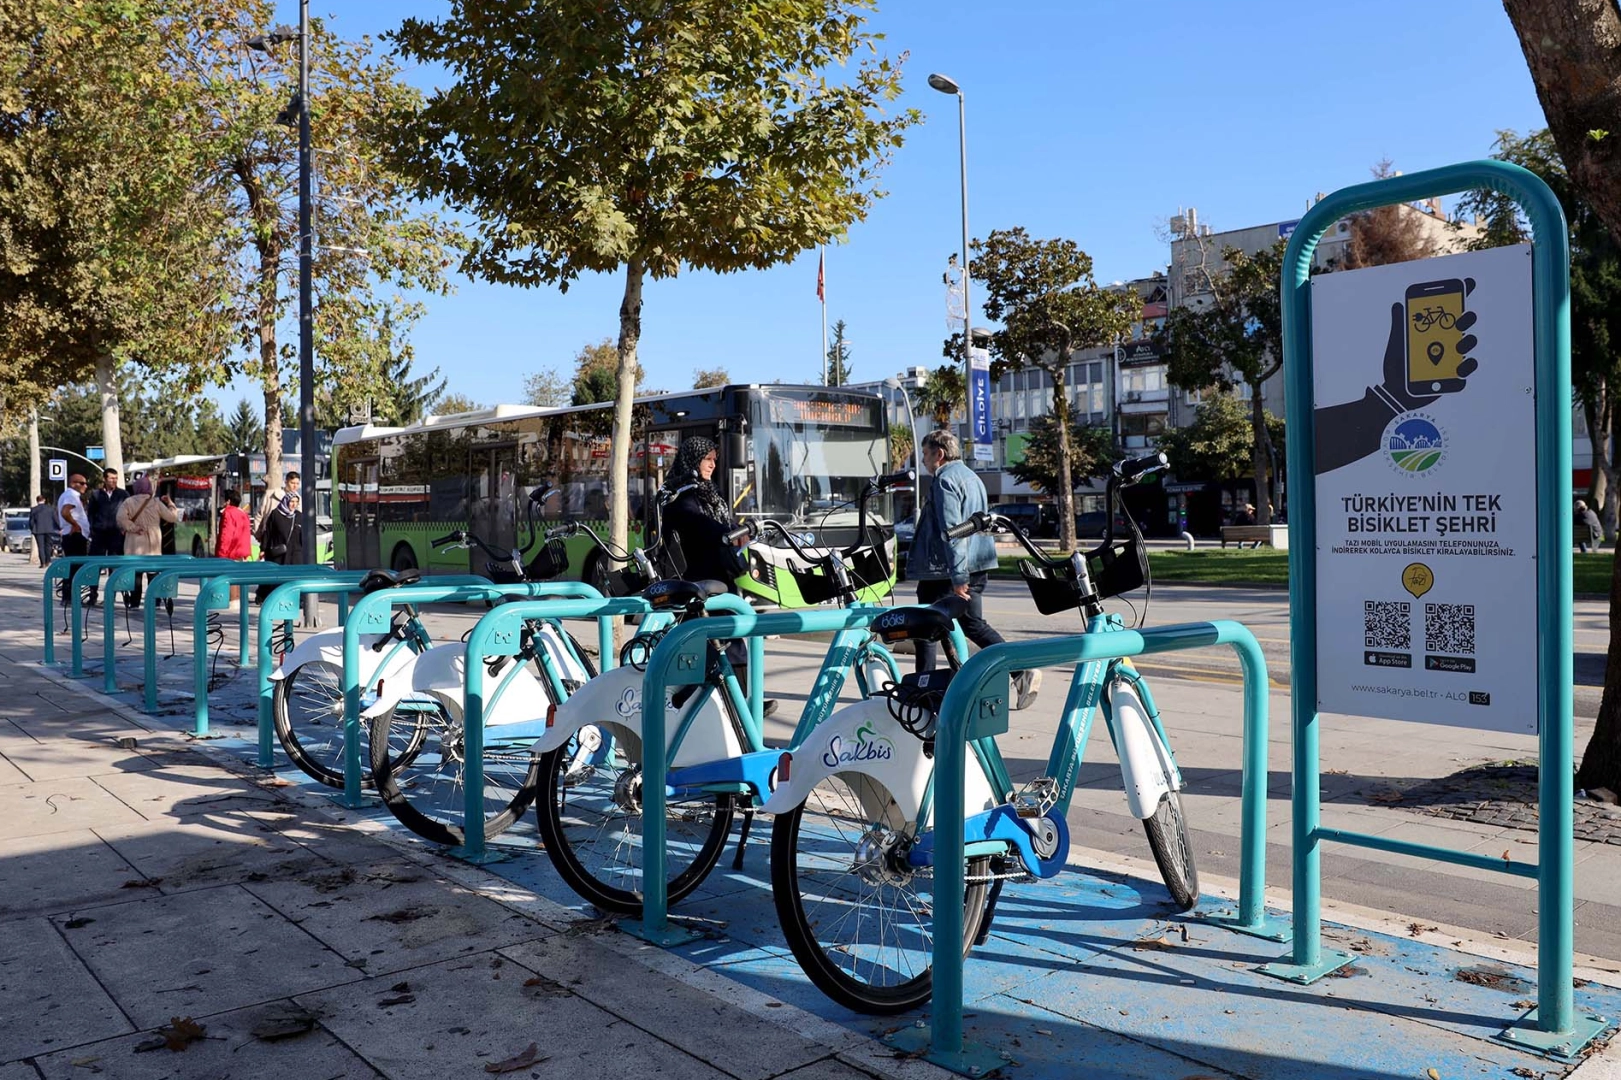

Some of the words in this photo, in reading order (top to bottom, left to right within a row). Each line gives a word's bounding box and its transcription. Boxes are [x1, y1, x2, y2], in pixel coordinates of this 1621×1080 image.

[1394, 412, 1436, 425] SAKARYA
[52, 464, 62, 476] D
[1341, 492, 1456, 513] TÜRKİYE'NİN
[1462, 494, 1502, 511] TEK
[1348, 513, 1430, 532] BİSİKLET
[1436, 512, 1496, 537] ŞEHRİ
[1361, 539, 1382, 547] MOBİL
[1384, 540, 1437, 548] UYGULAMASINI
[1331, 545, 1368, 554] İNDİREREK
[1403, 547, 1435, 555] BİSİKLET
[1379, 657, 1391, 665] App
[1392, 658, 1407, 666] Store
[1439, 662, 1459, 670] Google
[1460, 663, 1472, 671] Play
[1351, 684, 1438, 699] www.sakarya.bel.tr
[1446, 692, 1467, 702] ALO
[1471, 692, 1488, 704] 153
[823, 735, 892, 767] Sakbis
